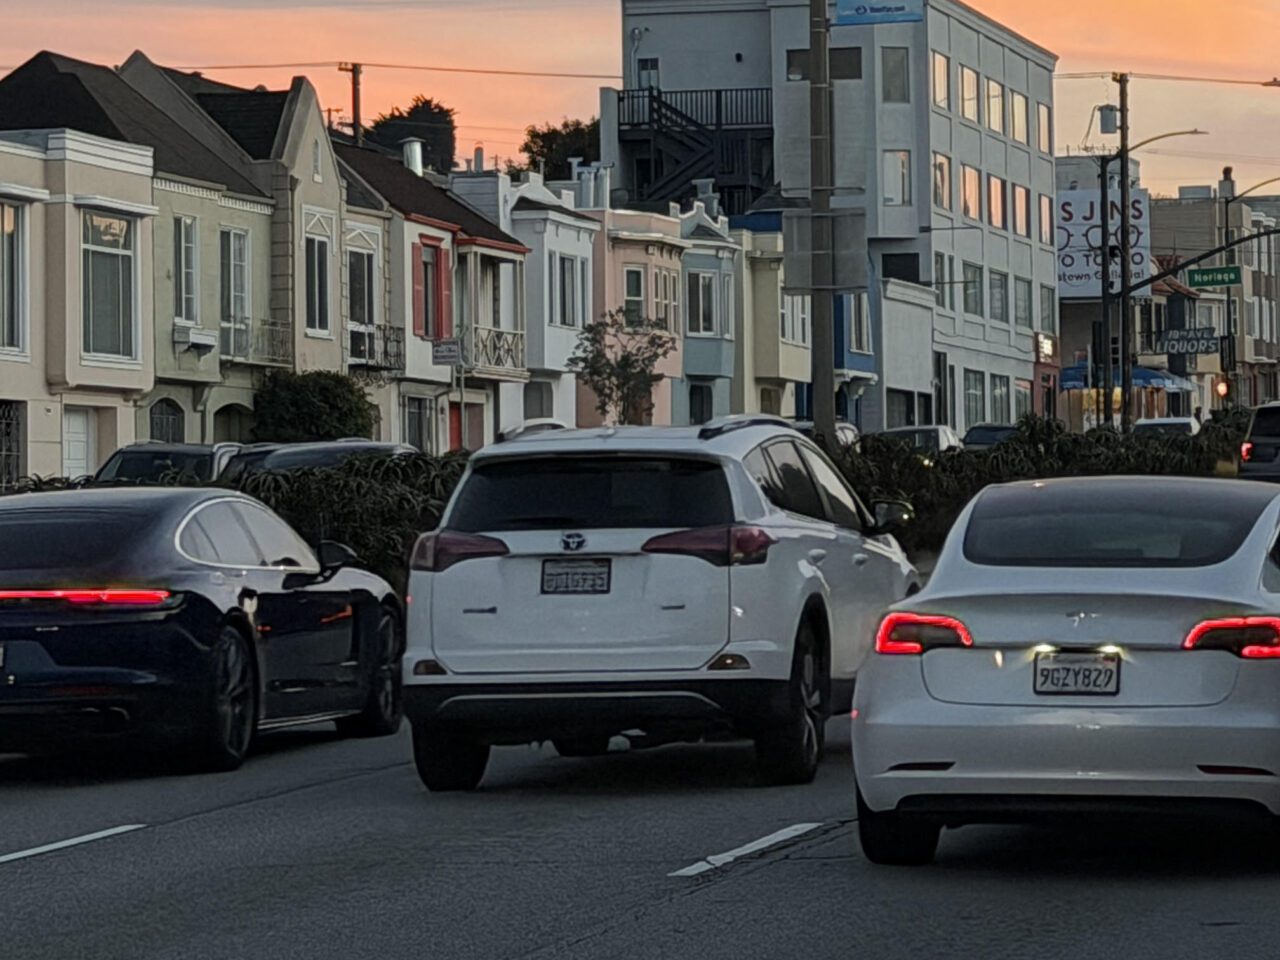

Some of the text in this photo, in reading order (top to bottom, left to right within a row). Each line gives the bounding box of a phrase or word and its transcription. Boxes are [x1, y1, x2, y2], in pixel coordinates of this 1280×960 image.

[1082, 199, 1143, 221] JNS
[1082, 251, 1145, 267] TOKO
[1194, 271, 1237, 283] Noriega
[1156, 341, 1217, 354] LIQUORS
